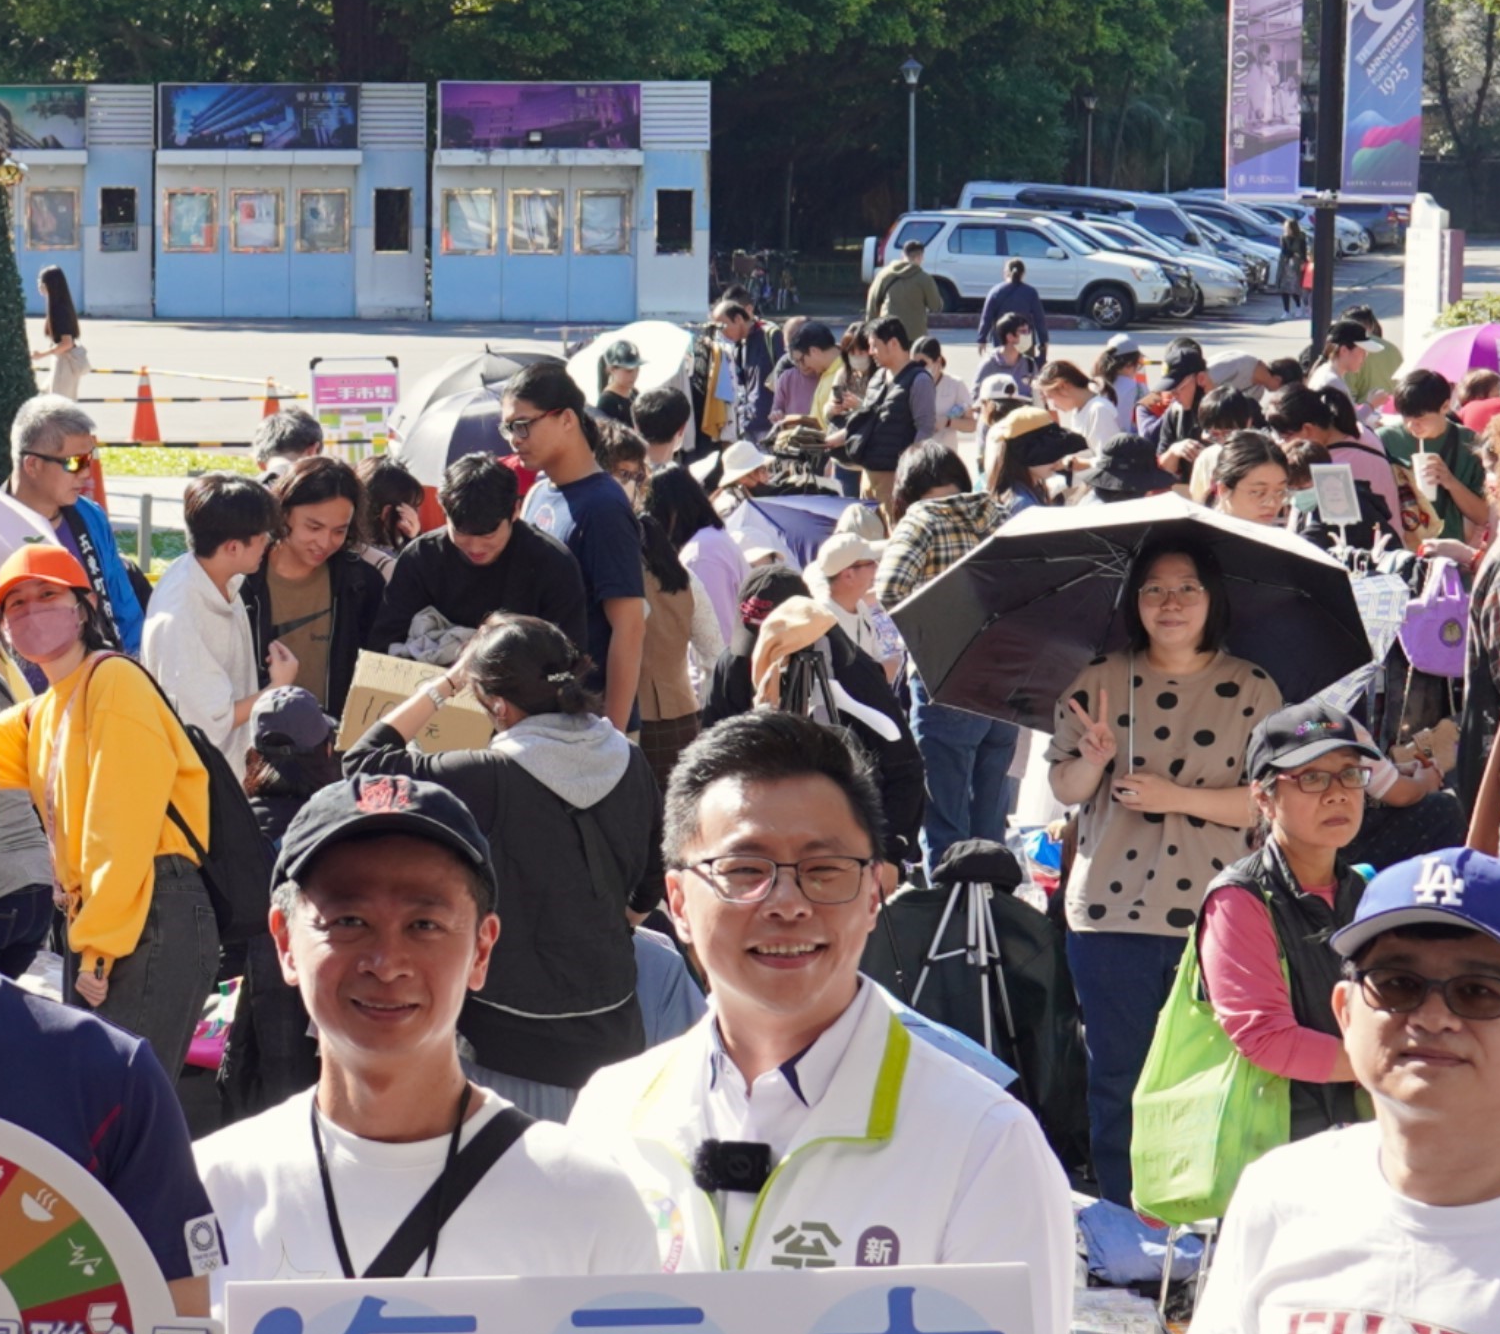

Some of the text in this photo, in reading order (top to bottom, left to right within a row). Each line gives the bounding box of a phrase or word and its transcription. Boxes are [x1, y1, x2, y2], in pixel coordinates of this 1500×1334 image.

[1366, 12, 1417, 77] ANNIVERSARY
[1378, 62, 1410, 96] 1925
[319, 386, 393, 400] 二手市集
[1413, 857, 1464, 906] LA
